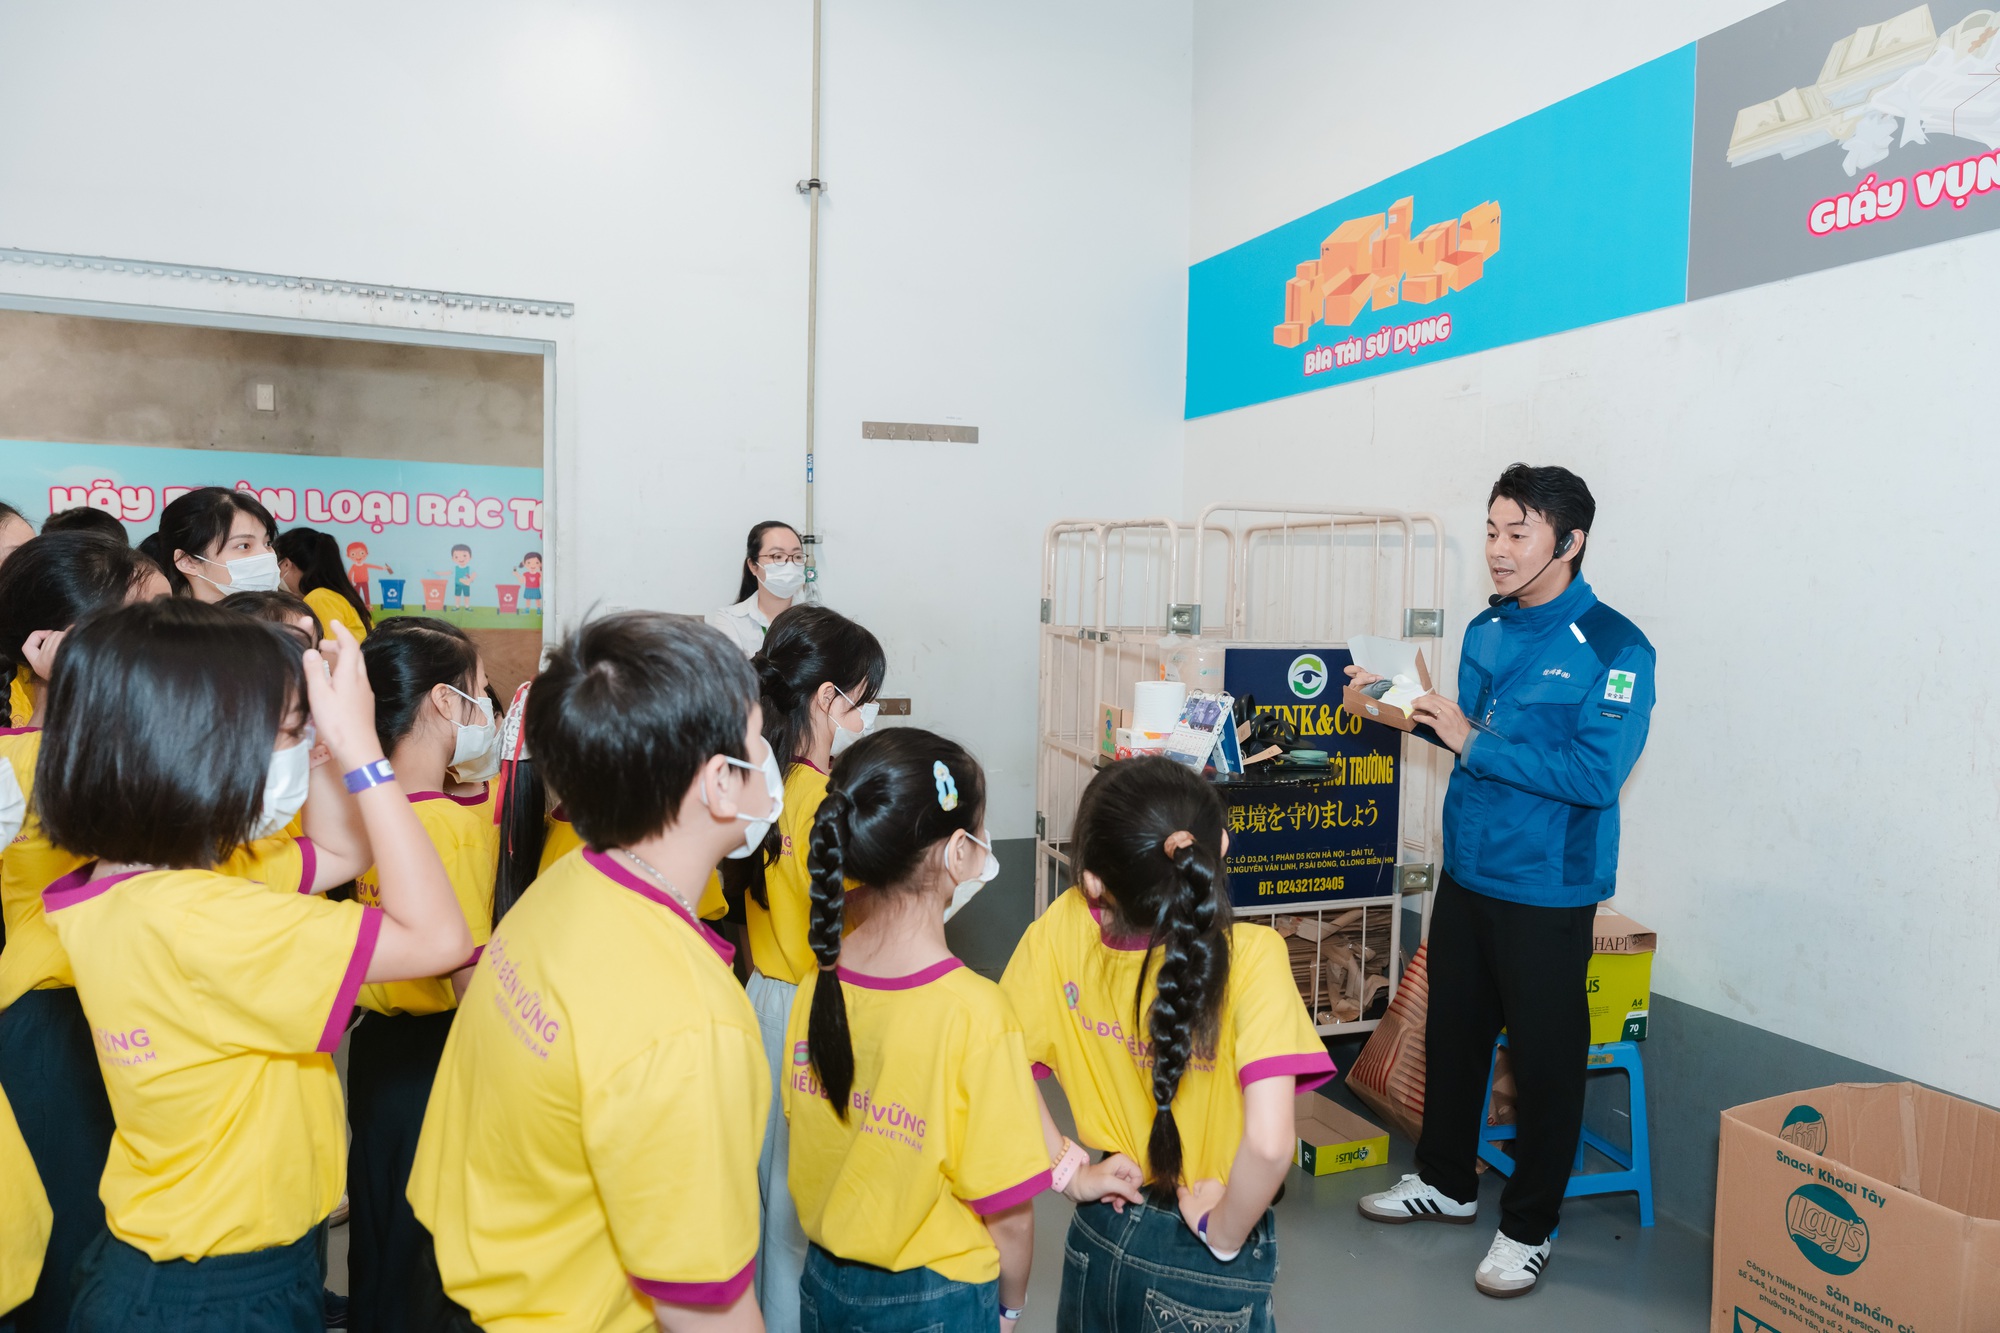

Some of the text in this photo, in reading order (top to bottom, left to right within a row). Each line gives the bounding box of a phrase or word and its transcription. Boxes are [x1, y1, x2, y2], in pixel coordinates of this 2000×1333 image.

[1808, 173, 1906, 236] GIẤY
[1304, 313, 1452, 376] BÌA TÁI SỬ DỤNG
[49, 480, 154, 522] HÃY
[305, 488, 409, 534] LOẠI
[417, 489, 504, 529] RÁC
[1349, 749, 1393, 785] TRƯỜNG
[1227, 799, 1378, 834] 環境を守りましょう
[1306, 851, 1321, 860] KCN
[1321, 849, 1332, 858] HÀ
[1333, 849, 1345, 858] NỘI
[1340, 858, 1365, 867] Q.LONG
[1258, 876, 1344, 895] ĐT: 02432123405
[1631, 998, 1643, 1007] A4
[1629, 1023, 1639, 1033] 70
[872, 1102, 926, 1138] VỮNG
[1776, 1150, 1886, 1208] Snack Khoai Tây
[1791, 1195, 1864, 1256] Lay's
[1738, 1269, 1747, 1279] Số
[1769, 1286, 1778, 1296] Lô
[1779, 1292, 1797, 1308] CN2,
[1799, 1303, 1824, 1324] Đường
[1826, 1320, 1836, 1328] số
[1746, 1260, 1766, 1277] Công
[1767, 1271, 1775, 1280] ty
[1776, 1276, 1796, 1292] TNHH
[1797, 1287, 1818, 1303] THỰC
[1820, 1299, 1843, 1317] PHẨM
[1826, 1284, 1850, 1306] Sản
[1854, 1300, 1894, 1328] phẩm
[1759, 1294, 1787, 1315] phường
[1789, 1309, 1802, 1322] Phú
